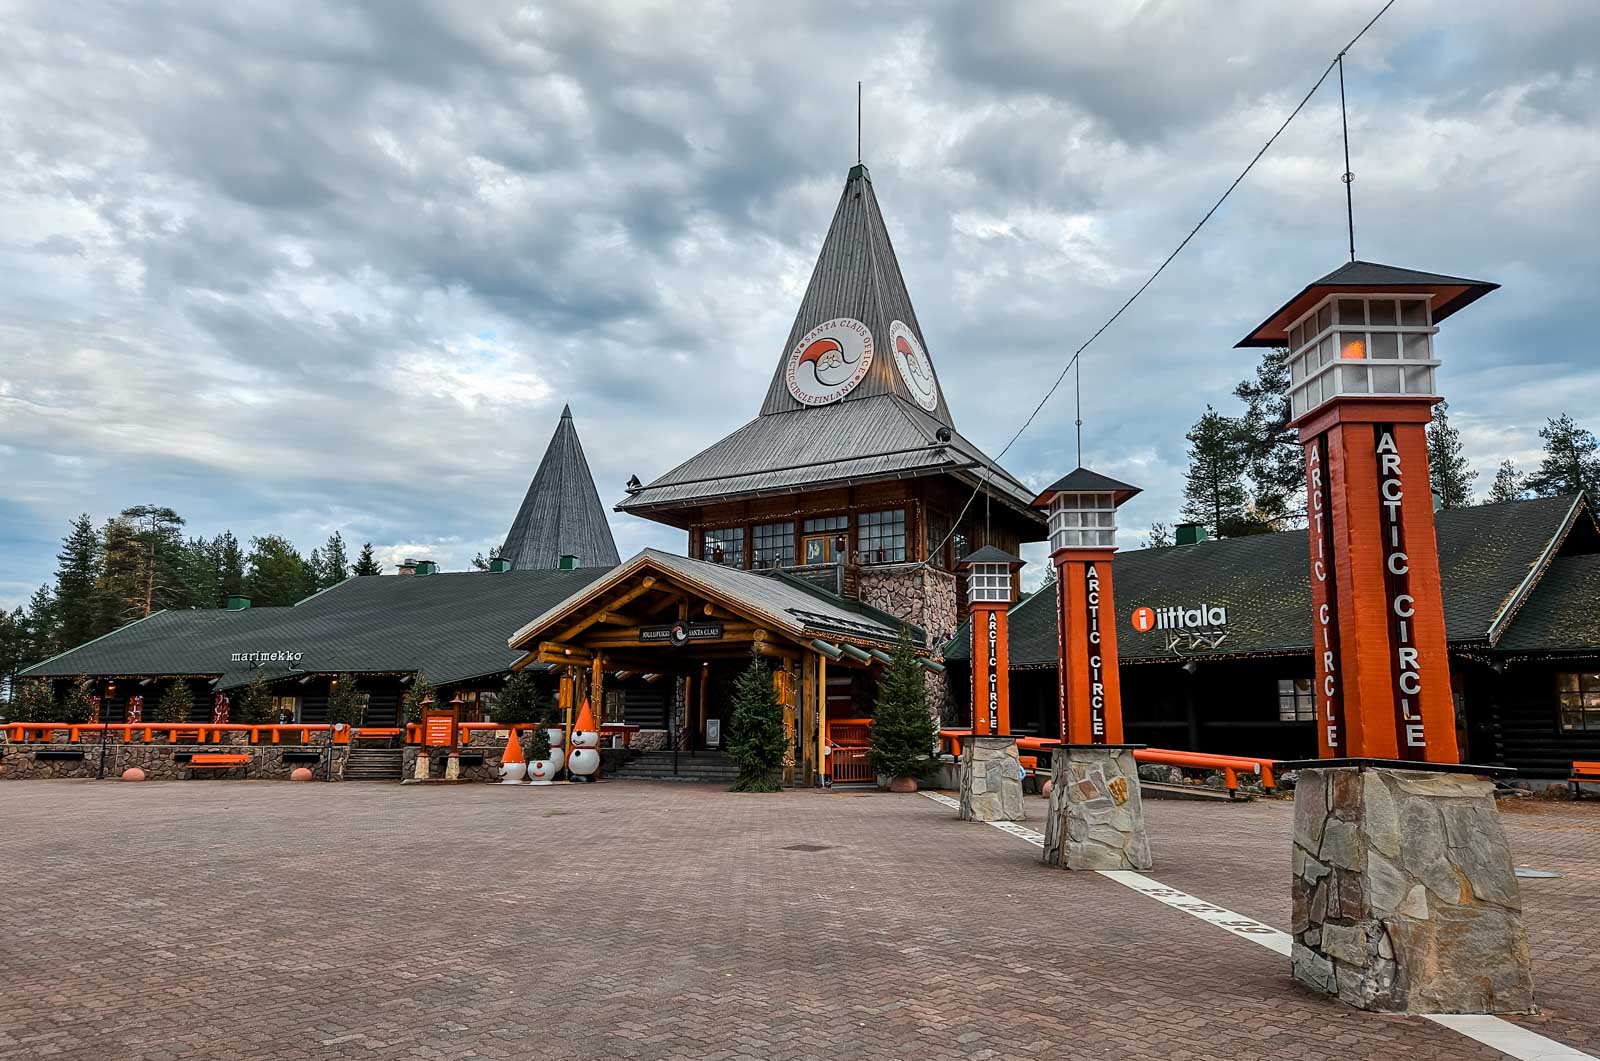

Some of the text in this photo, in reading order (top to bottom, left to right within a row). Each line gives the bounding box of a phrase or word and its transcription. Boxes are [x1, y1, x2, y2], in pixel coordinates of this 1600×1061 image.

[788, 348, 856, 404] ARCTIC CIRCLE FINLAND
[804, 320, 872, 374] SANTA CLAUS OFFICE
[1156, 603, 1227, 630] iittala
[1309, 445, 1338, 748] ARCTIC CIRCLE
[1377, 432, 1426, 748] ARCTIC CIRCLE
[231, 650, 304, 662] marimekko
[989, 612, 998, 729] ARCTIC CIRCLE
[1086, 566, 1104, 735] ARCTIC CIRCLE
